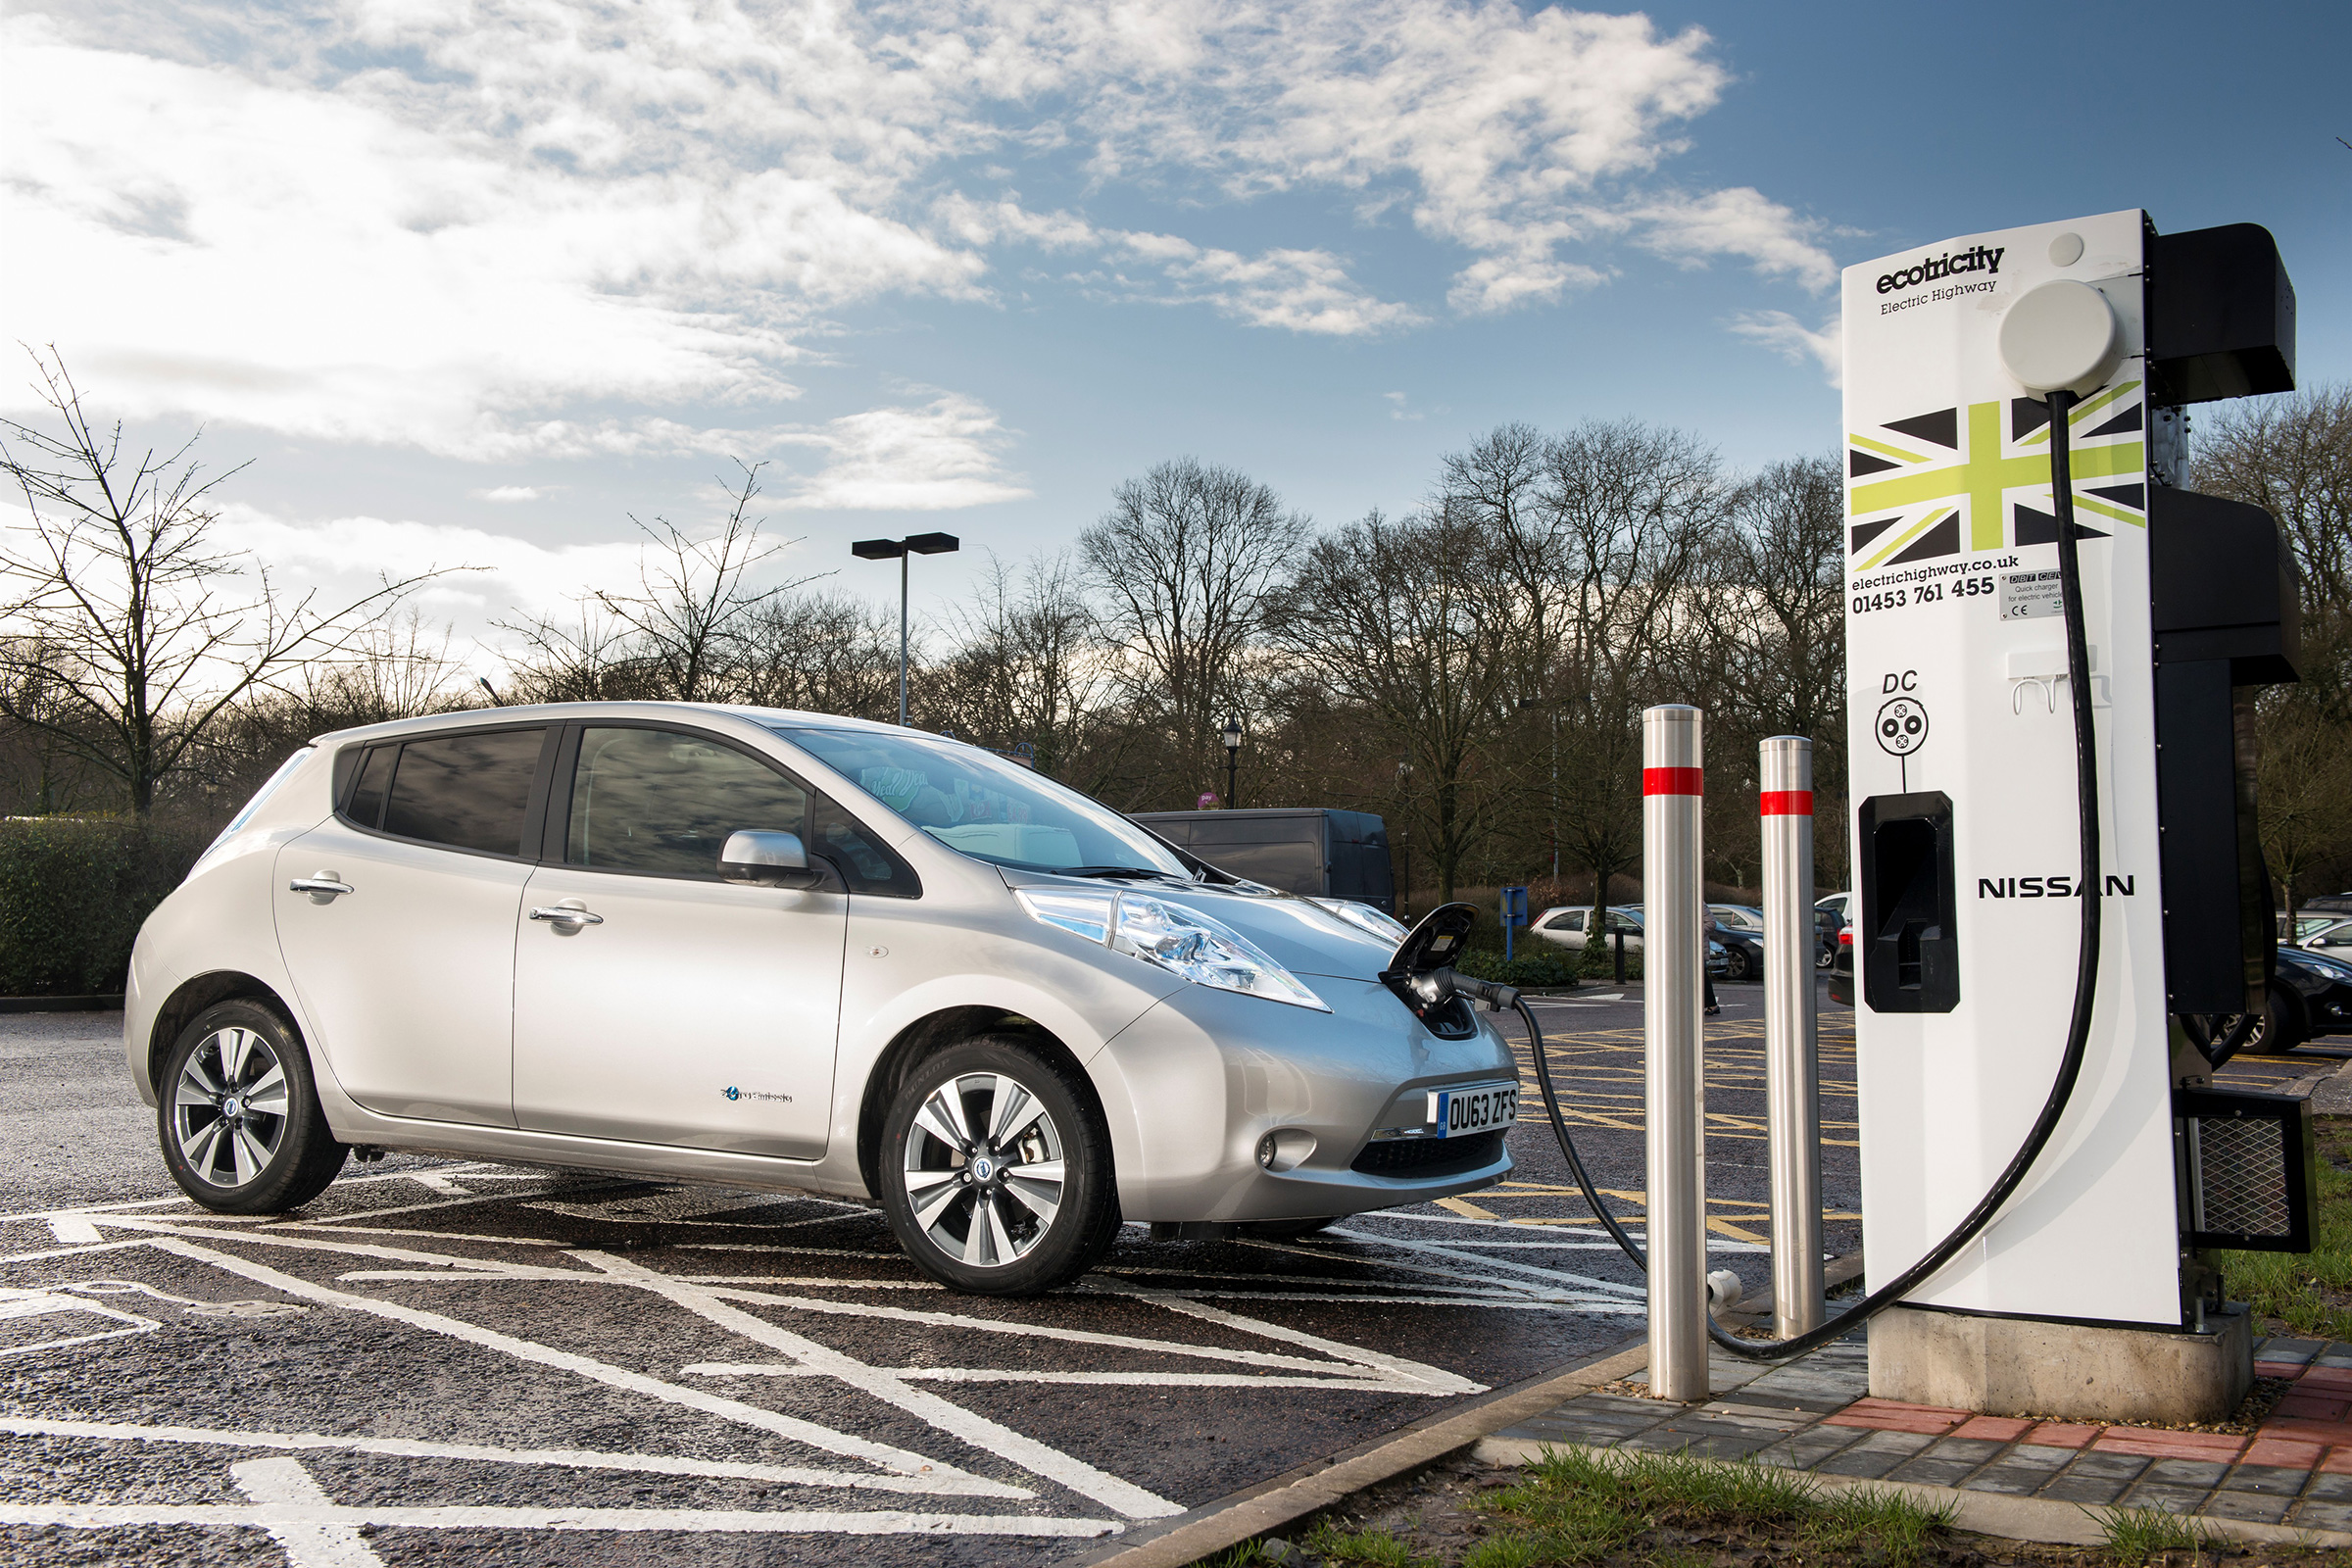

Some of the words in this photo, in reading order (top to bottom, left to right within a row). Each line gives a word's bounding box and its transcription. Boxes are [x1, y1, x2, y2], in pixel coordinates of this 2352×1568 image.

[1876, 245, 2005, 294] ecotricity
[1881, 294, 1928, 316] Electric
[1932, 280, 1997, 302] Highway
[1852, 556, 2019, 591] electrichighway.co.uk
[2010, 573, 2036, 584] DBT
[2015, 584, 2034, 593] Quick
[2034, 583, 2058, 592] charger
[1852, 588, 1907, 614] 01453
[1914, 583, 1943, 605] 761
[1951, 576, 1995, 598] 455
[2018, 593, 2041, 602] electric
[1882, 669, 1918, 695] DC
[1449, 1094, 1490, 1131] OU63
[1492, 1089, 1517, 1124] ZFS
